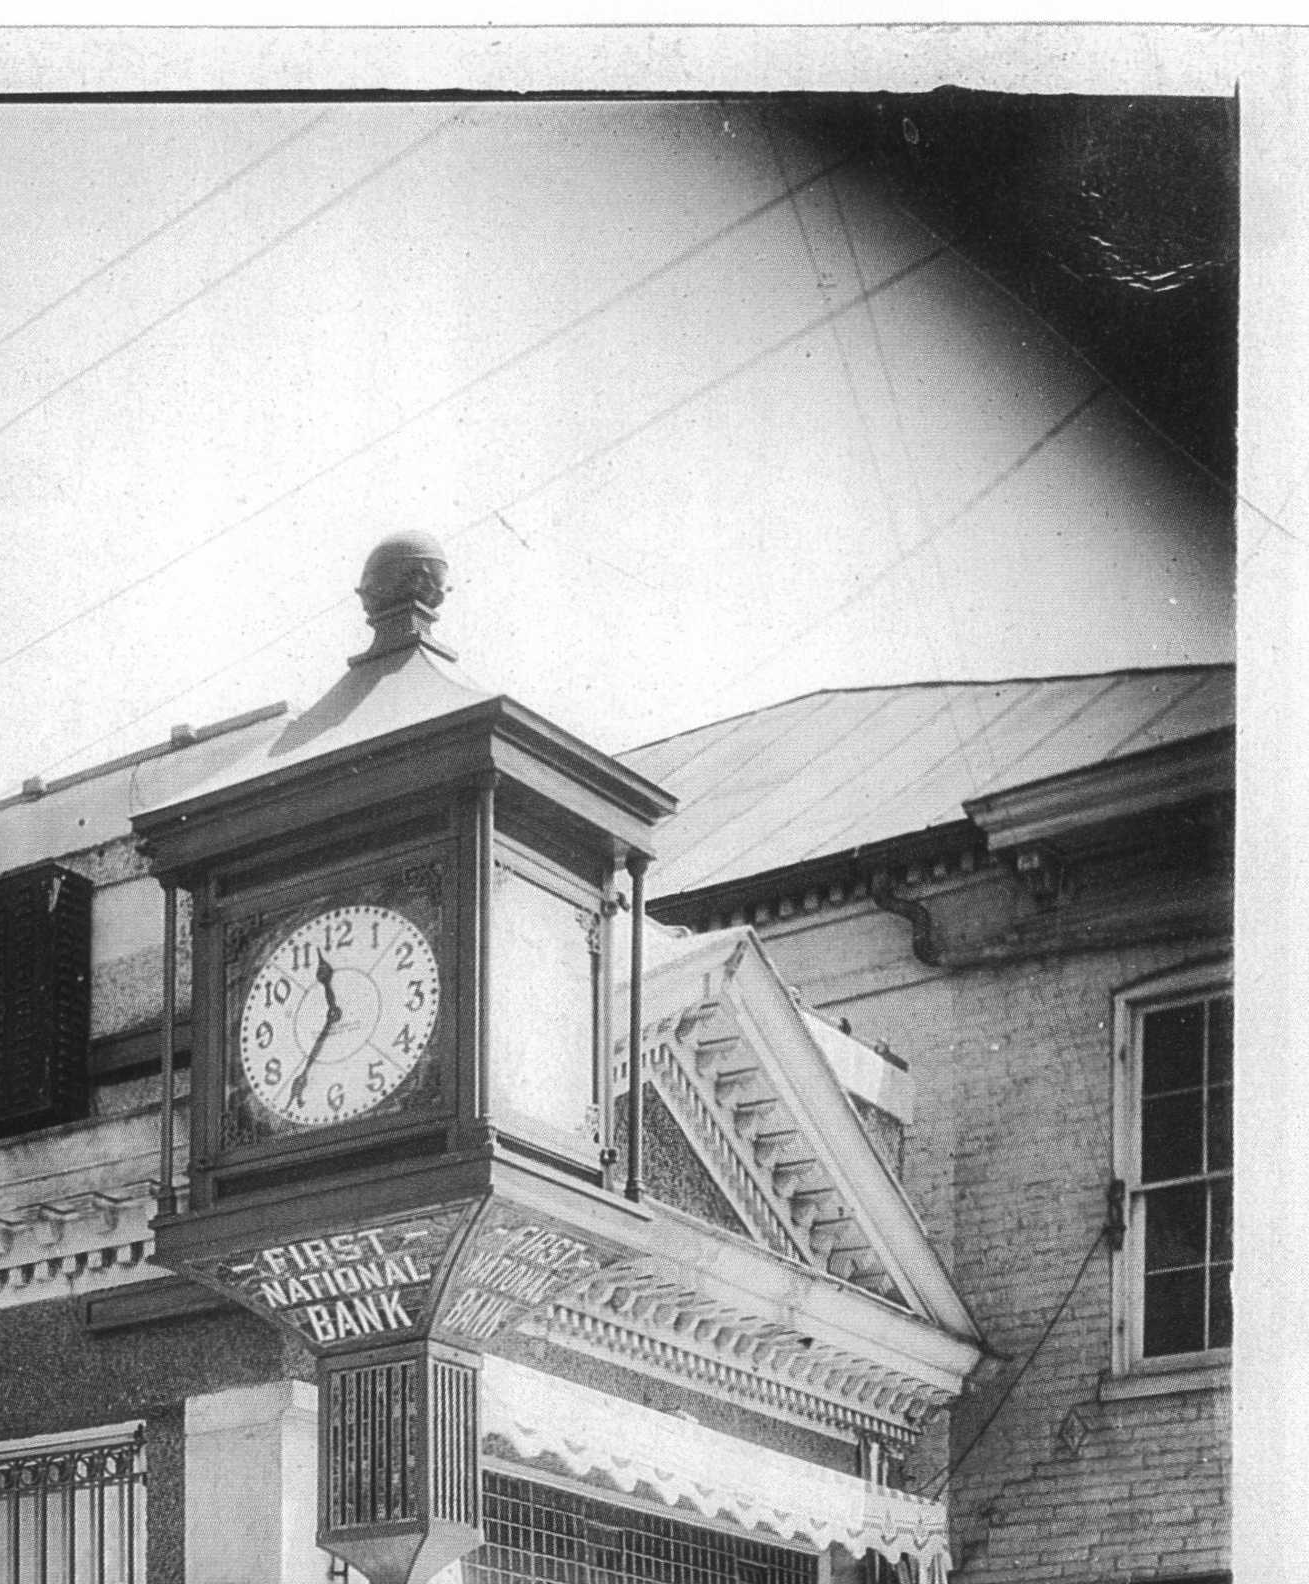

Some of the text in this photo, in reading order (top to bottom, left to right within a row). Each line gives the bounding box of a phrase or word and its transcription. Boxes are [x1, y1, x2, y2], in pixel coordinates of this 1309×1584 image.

[324, 919, 355, 953] 12
[371, 921, 380, 950] 1
[291, 941, 312, 972] 11
[394, 941, 415, 971] 2
[264, 977, 292, 1009] 10
[405, 979, 425, 1012] 3
[255, 1020, 274, 1049] 9
[391, 1023, 417, 1054] 4
[263, 1057, 282, 1086] 8
[365, 1059, 386, 1093] 5
[326, 1082, 345, 1111] 6
[262, 1227, 385, 1275] FIRST
[260, 1255, 432, 1309] NATIONAL
[306, 1290, 413, 1342] BANK
